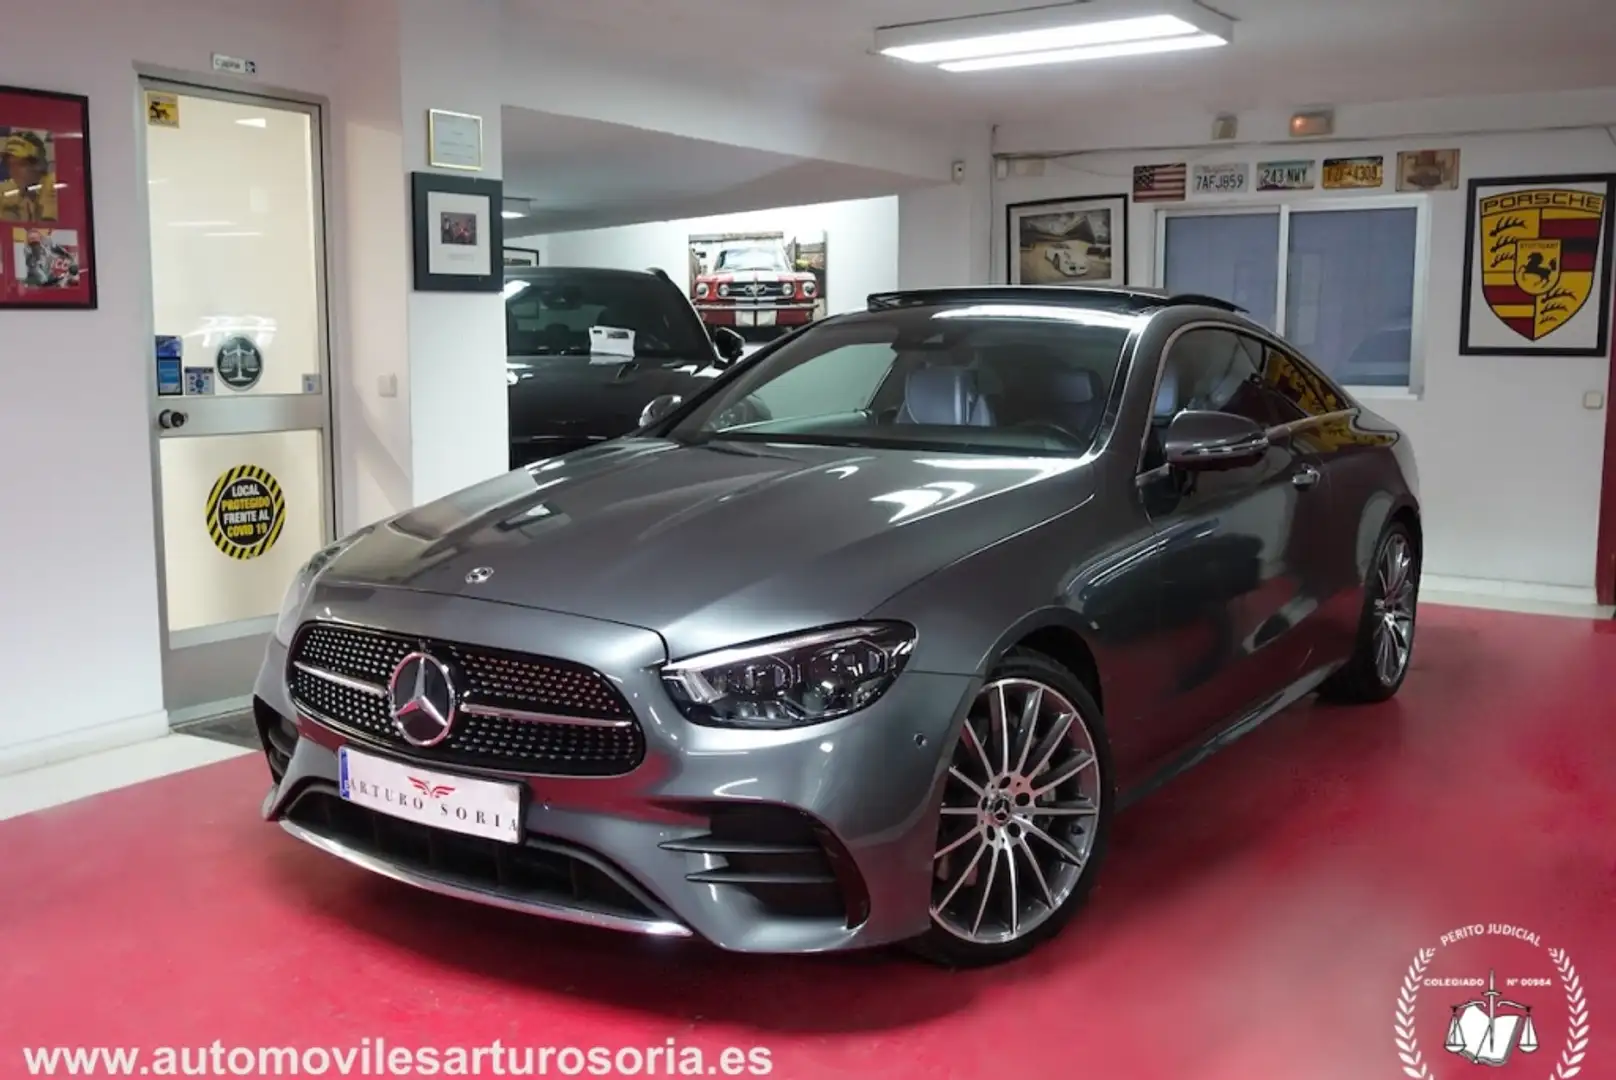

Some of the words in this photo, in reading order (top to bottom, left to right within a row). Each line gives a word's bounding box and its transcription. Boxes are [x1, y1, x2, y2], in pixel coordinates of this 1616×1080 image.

[1483, 192, 1601, 213] PORSCHE
[232, 485, 260, 497] LOCAL
[222, 496, 269, 511] PROTEGIDO
[224, 511, 256, 524] FRENTE
[259, 509, 270, 520] AL
[228, 525, 253, 537] COVID
[256, 523, 267, 534] 19
[349, 778, 423, 810] ARTURO
[440, 803, 517, 832] SORIA
